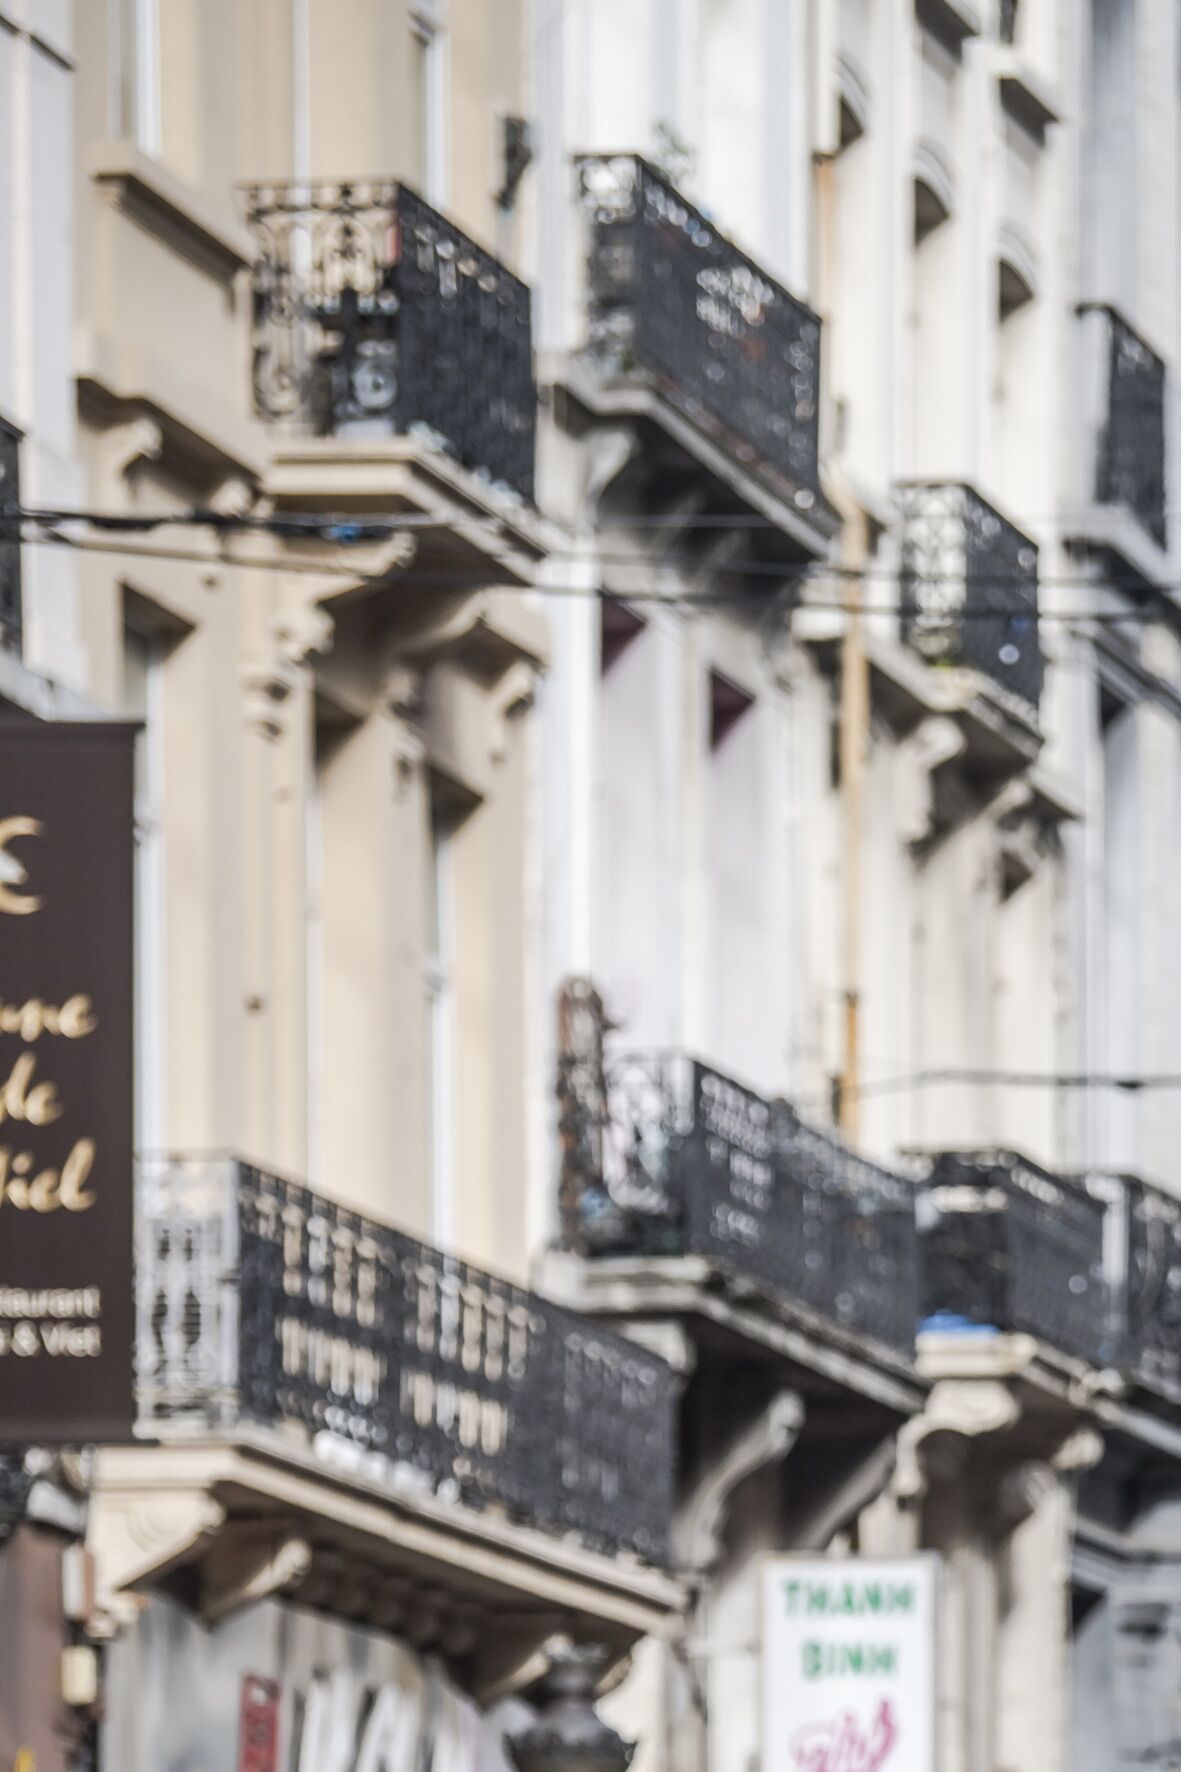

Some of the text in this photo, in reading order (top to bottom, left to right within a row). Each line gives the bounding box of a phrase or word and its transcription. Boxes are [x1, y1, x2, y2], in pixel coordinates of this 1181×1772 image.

[0, 1136, 97, 1213] iel
[781, 1578, 917, 1618] THANH
[801, 1637, 899, 1682] BINH
